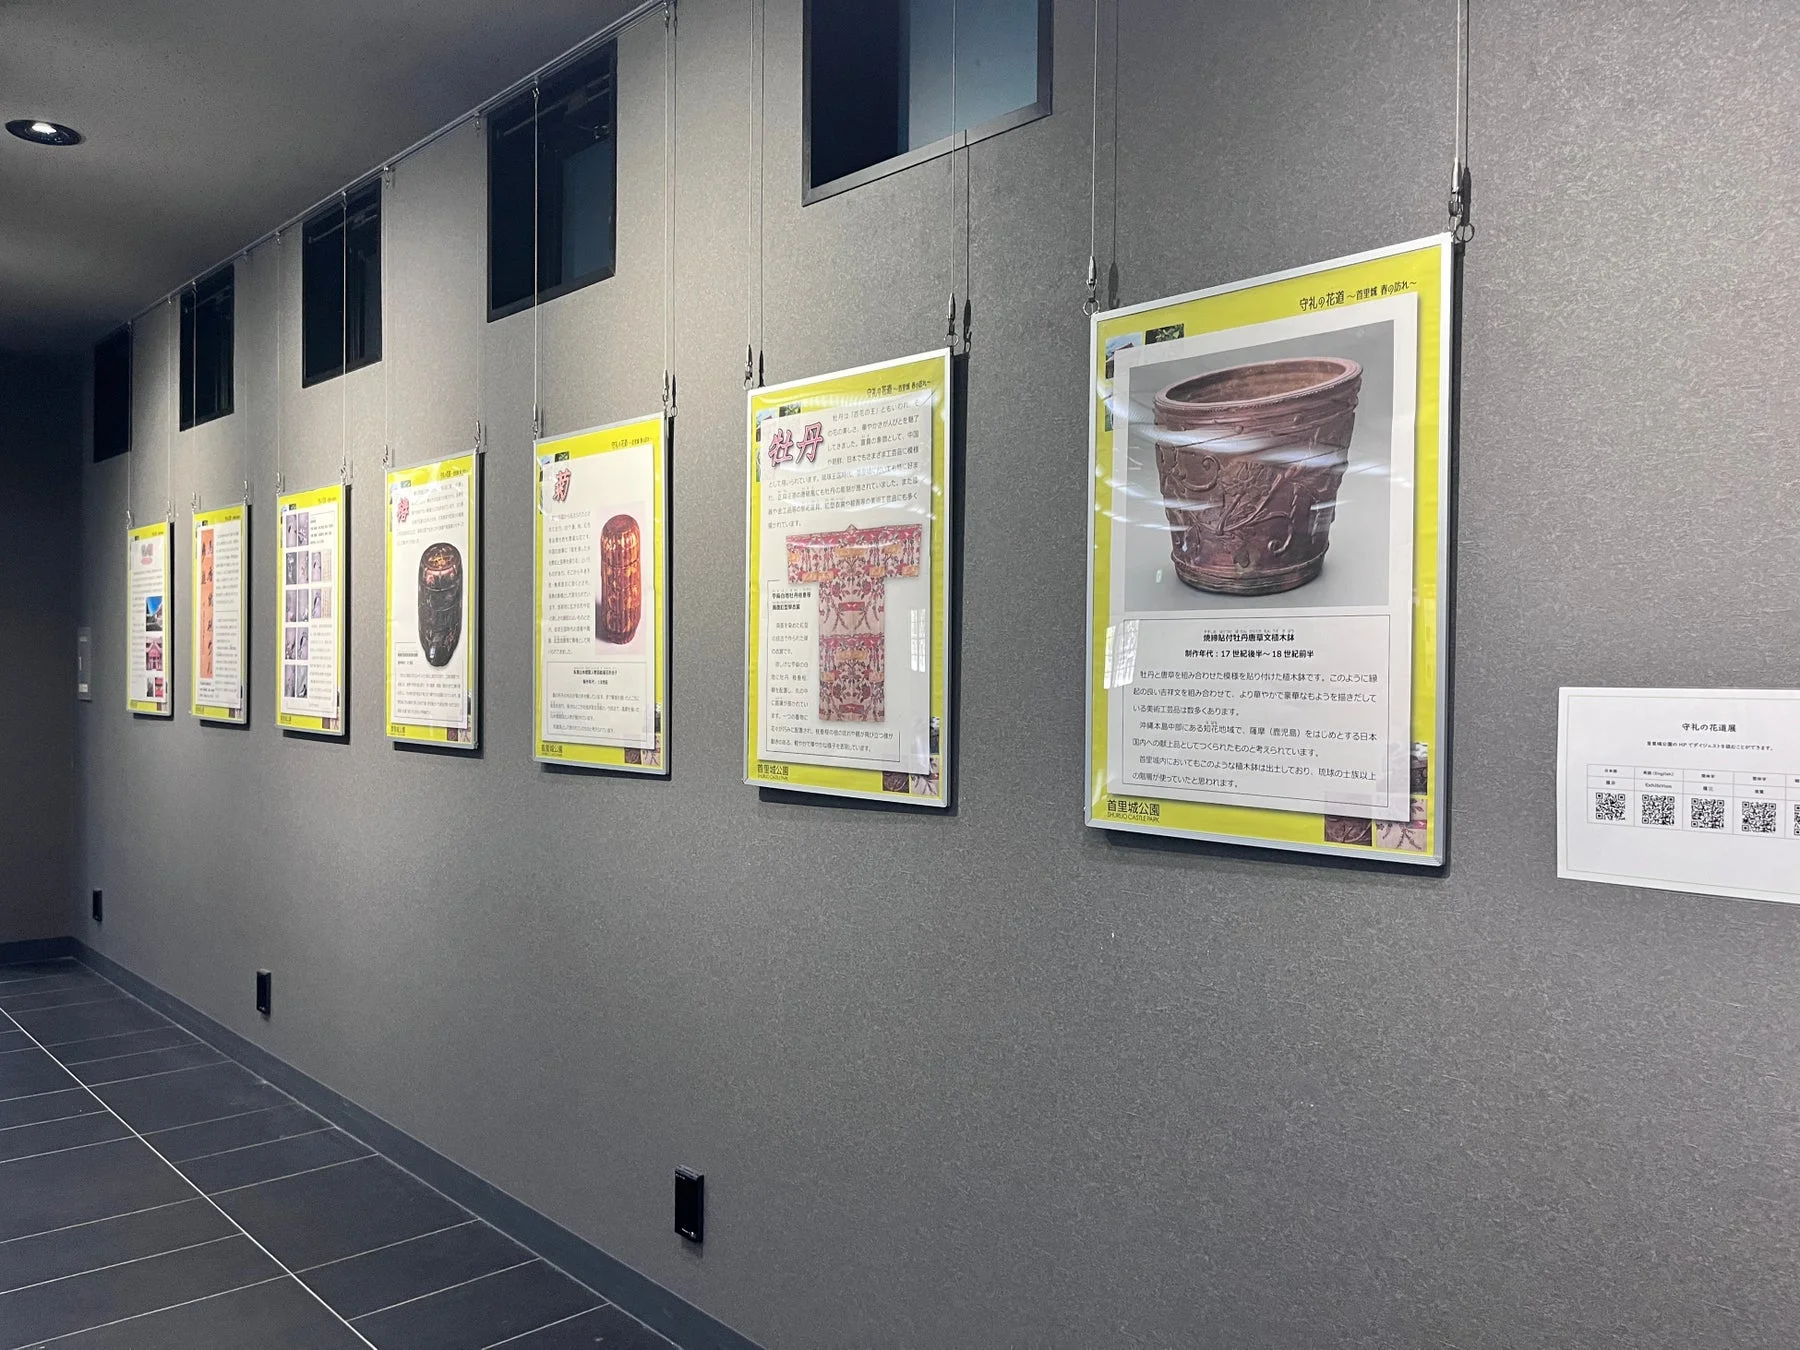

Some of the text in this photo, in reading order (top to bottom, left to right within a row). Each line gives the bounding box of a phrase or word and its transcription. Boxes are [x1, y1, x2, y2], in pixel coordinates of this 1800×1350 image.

[1299, 290, 1345, 311] 守礼の花道
[1381, 280, 1417, 296] 春の訪れ～
[767, 421, 824, 468] 牡丹
[552, 468, 572, 502] 菊
[1140, 670, 1378, 683] 牡丹と唐草を組み合わせた模様を貼り付けた植木鉢です。このように縁
[1132, 687, 1377, 703] 起の良い吉祥文を組み合わせて、より華やかで豪華なもようを描きだして
[1132, 705, 1240, 717] いる美術工芸品は数多くあります。
[1682, 722, 1737, 733] 守礼の花道展
[1132, 738, 1319, 757] 国内への献上品としてつくられたものと考えられています。
[757, 764, 789, 777] 首里城公園
[1107, 799, 1160, 817] 首里城公園
